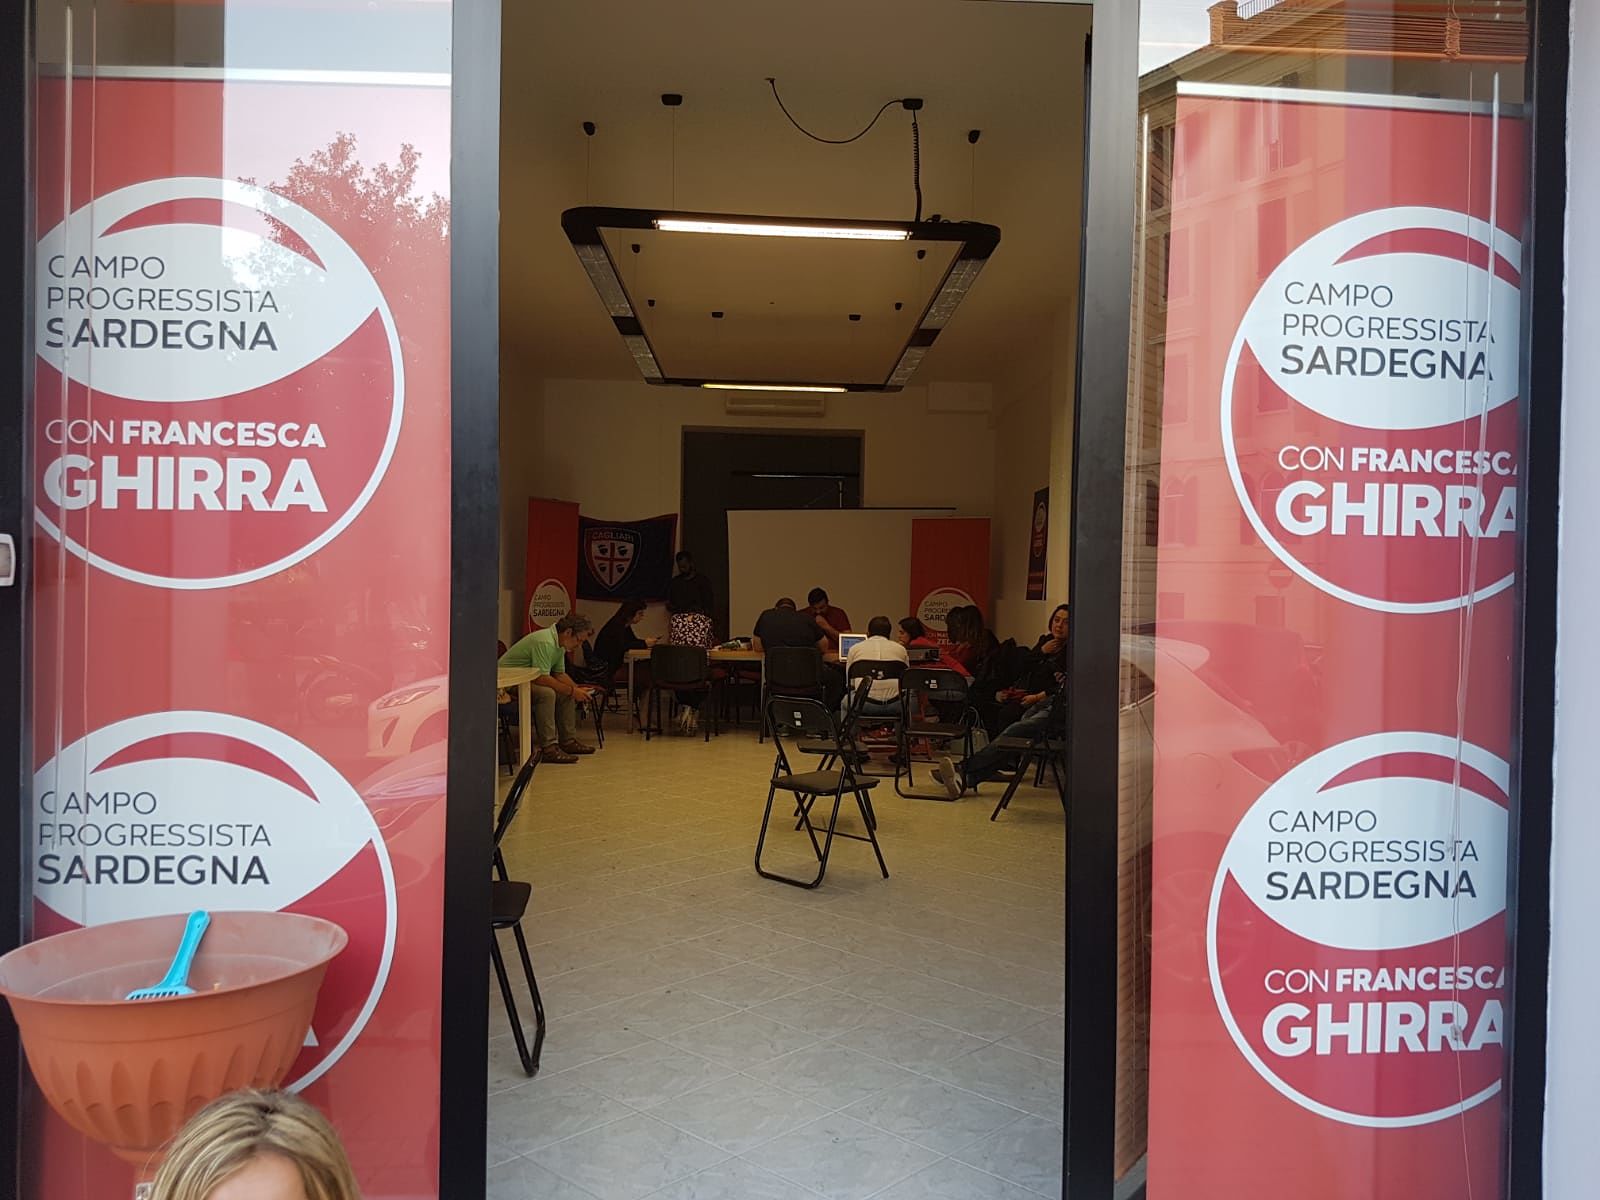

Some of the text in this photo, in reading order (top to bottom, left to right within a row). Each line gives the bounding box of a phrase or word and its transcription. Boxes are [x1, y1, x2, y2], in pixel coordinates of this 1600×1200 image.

[48, 255, 165, 279] CAMPO
[47, 286, 279, 314] PROGRESSISTA
[1284, 281, 1393, 308] CAMPO
[45, 317, 279, 351] SARDEGNA
[1282, 313, 1495, 344] PROGRESSISTA
[1280, 344, 1493, 381] SARDEGNA
[45, 419, 327, 448] CON FRANCESCA
[1278, 445, 1517, 476] CON FRANCESC
[43, 454, 328, 513] GHIRRA
[1275, 480, 1517, 538] GHIRRA
[39, 791, 157, 815] CAMPO
[38, 823, 272, 847] PROGRESSISTA
[1268, 810, 1377, 833] CAMPO
[1267, 840, 1479, 863] PROGRESSISTA
[37, 854, 271, 885] SARDEGNA
[1265, 870, 1477, 900] SARDEGNA
[1264, 969, 1329, 994] CON
[1262, 999, 1504, 1057] GHIRRA
